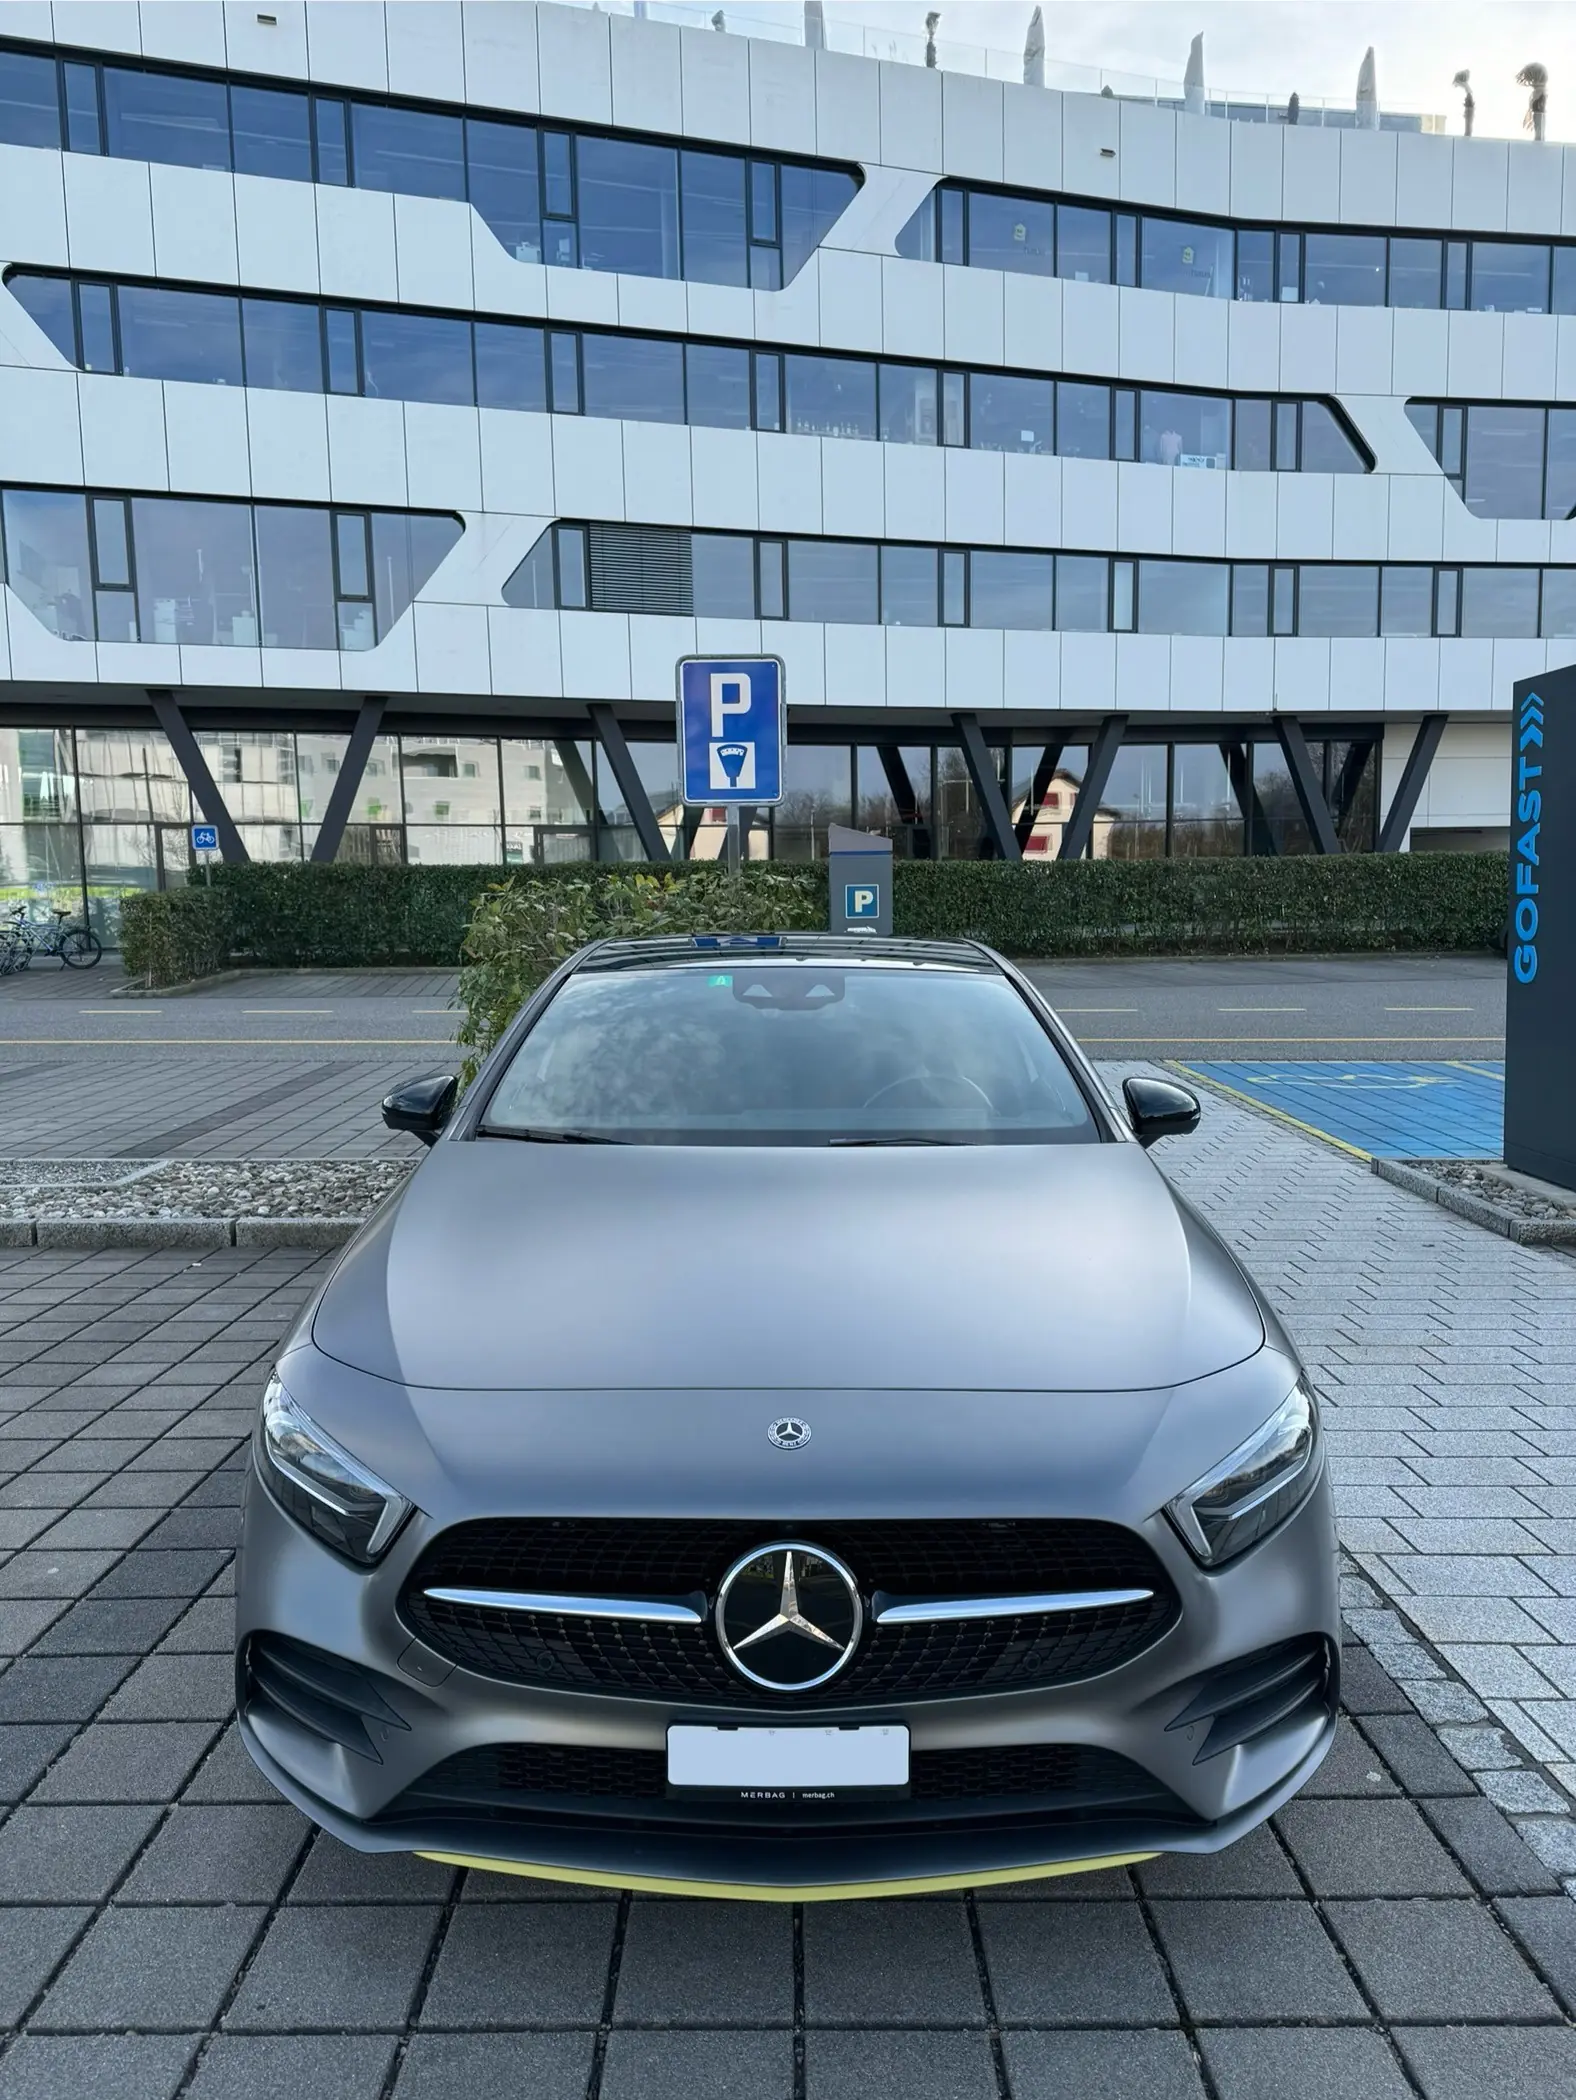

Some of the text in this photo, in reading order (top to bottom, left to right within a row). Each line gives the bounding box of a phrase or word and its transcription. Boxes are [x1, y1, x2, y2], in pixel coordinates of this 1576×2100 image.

[710, 673, 751, 737] P
[1514, 756, 1542, 984] GOFAST
[854, 890, 874, 913] P
[740, 1791, 835, 1800] MERBAG merbag.ch
